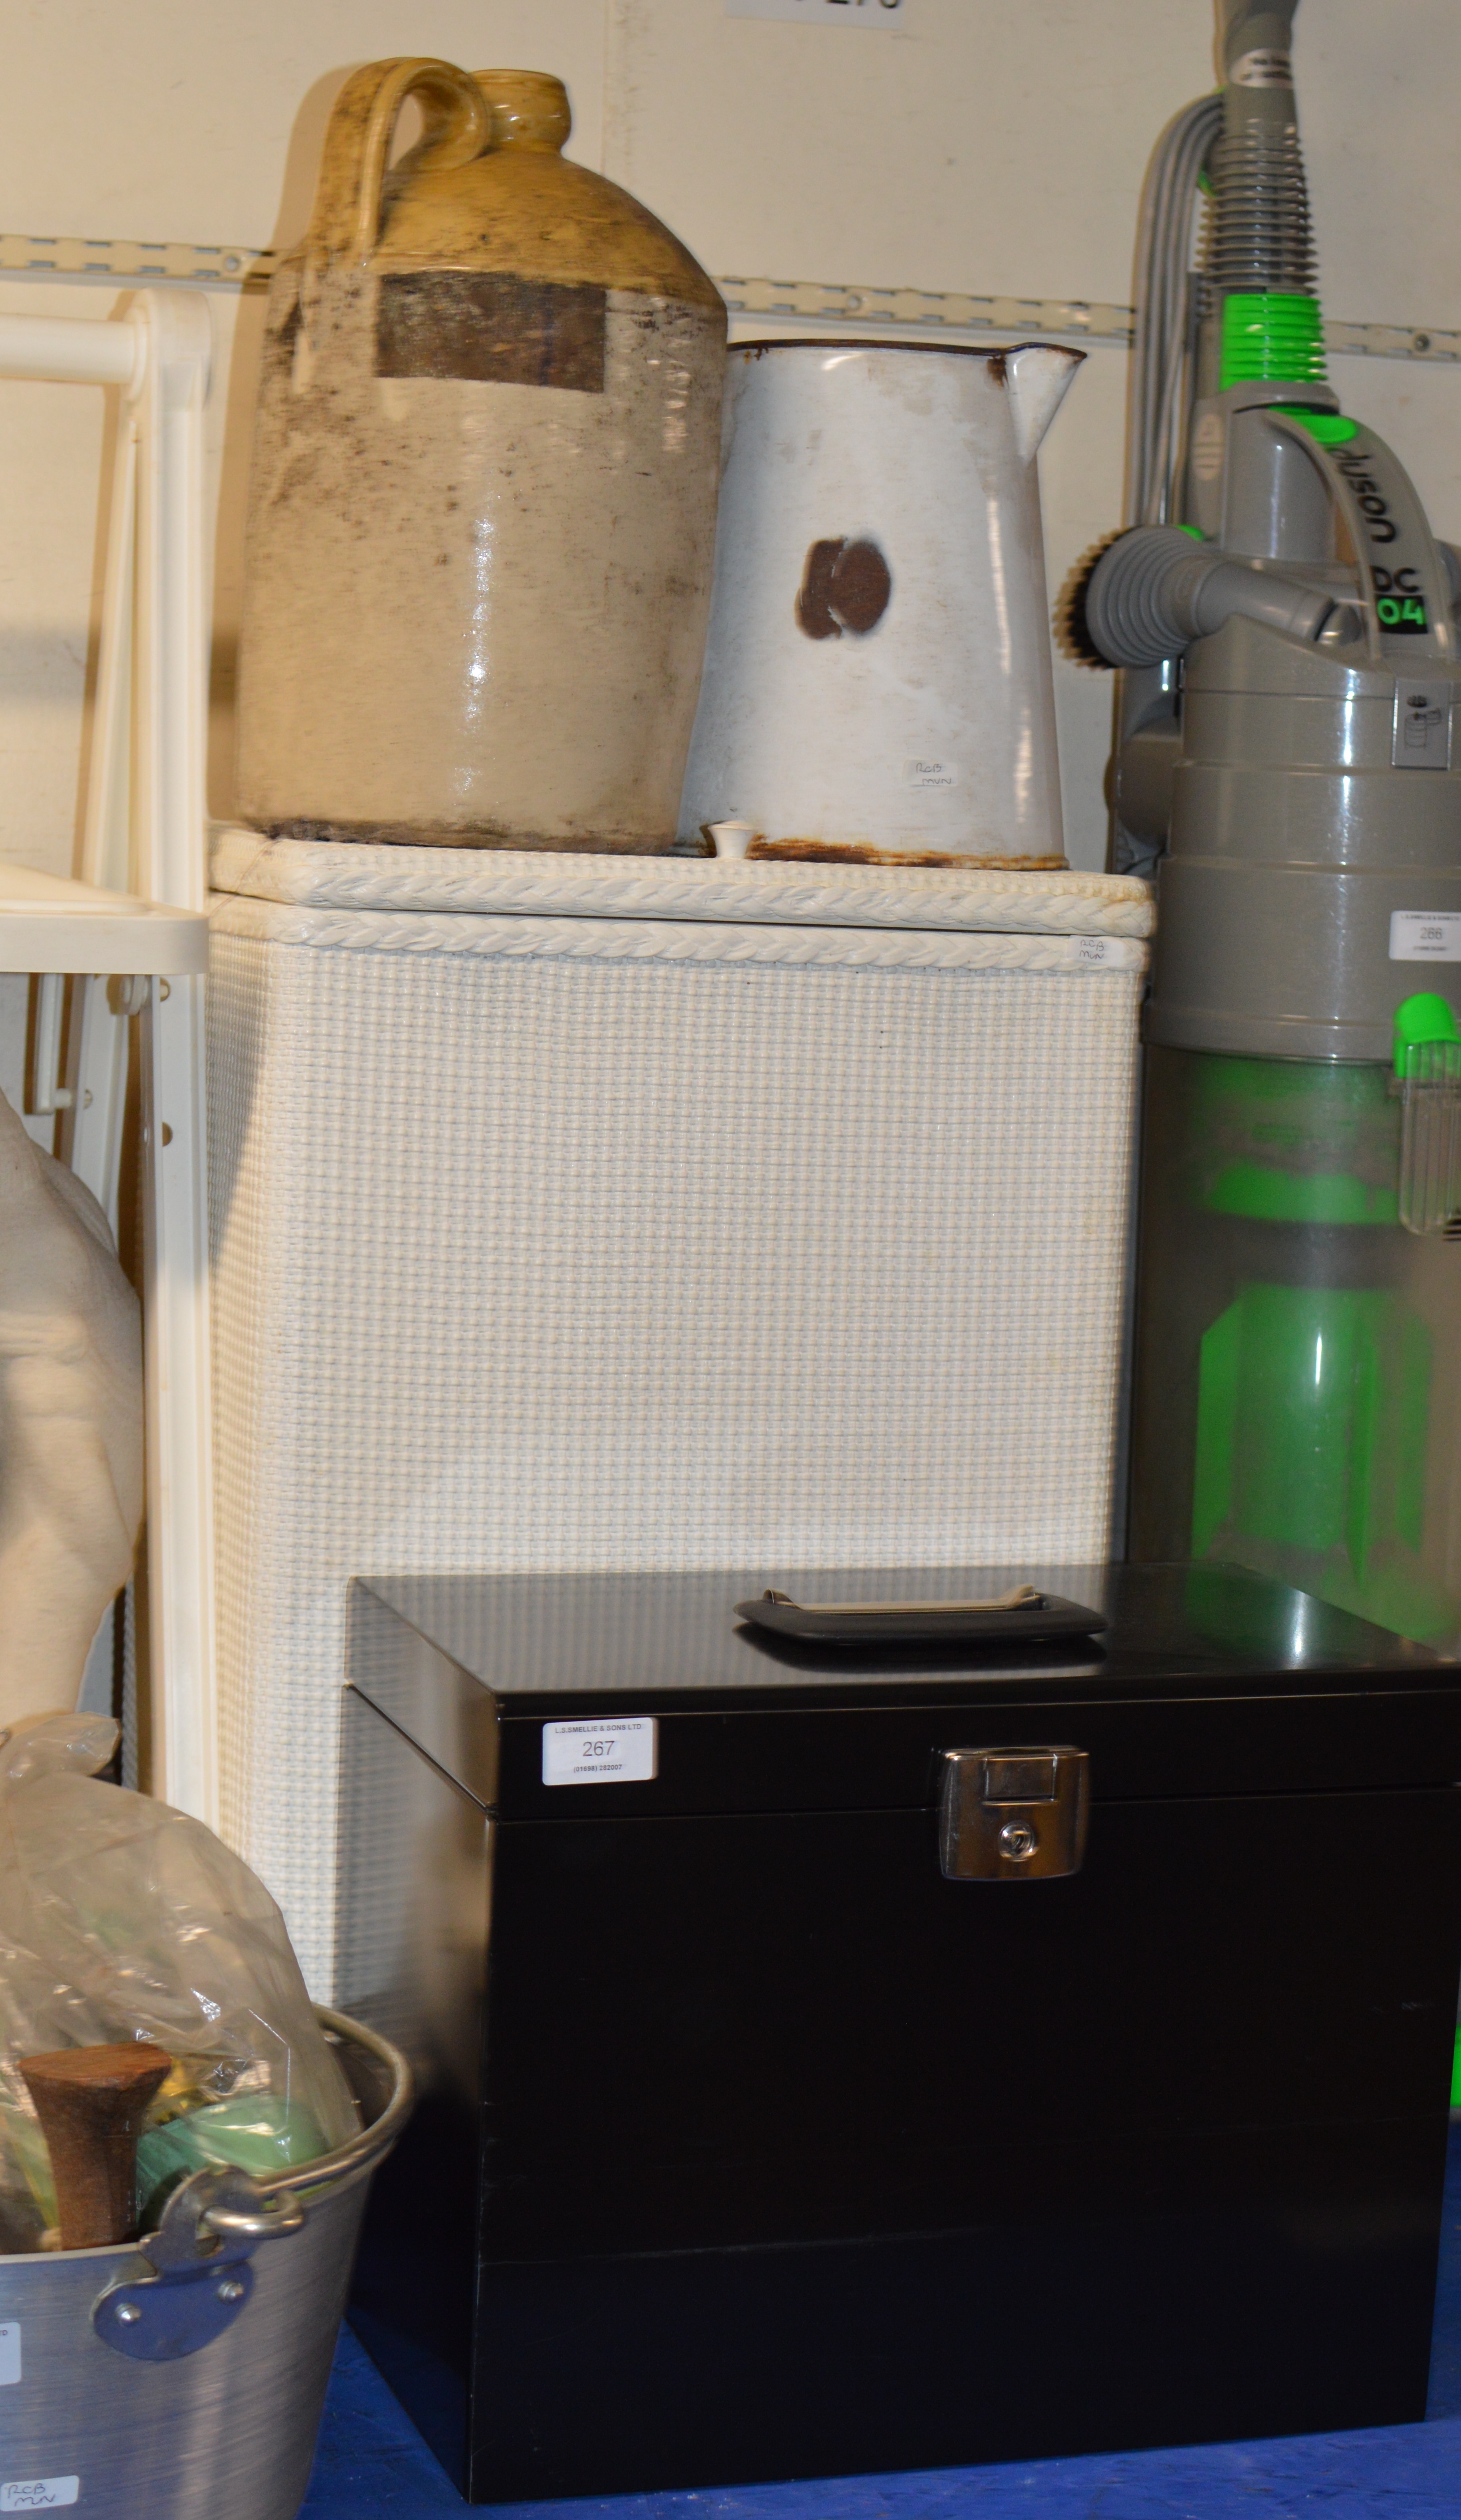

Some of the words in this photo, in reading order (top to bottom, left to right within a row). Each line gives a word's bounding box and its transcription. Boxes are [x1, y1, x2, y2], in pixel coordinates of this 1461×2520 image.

[1370, 566, 1419, 593] DC
[1377, 598, 1426, 625] 04
[1420, 927, 1442, 939] 266
[555, 1725, 598, 1734] L.S.SMELLIE
[583, 1740, 615, 1757] 267
